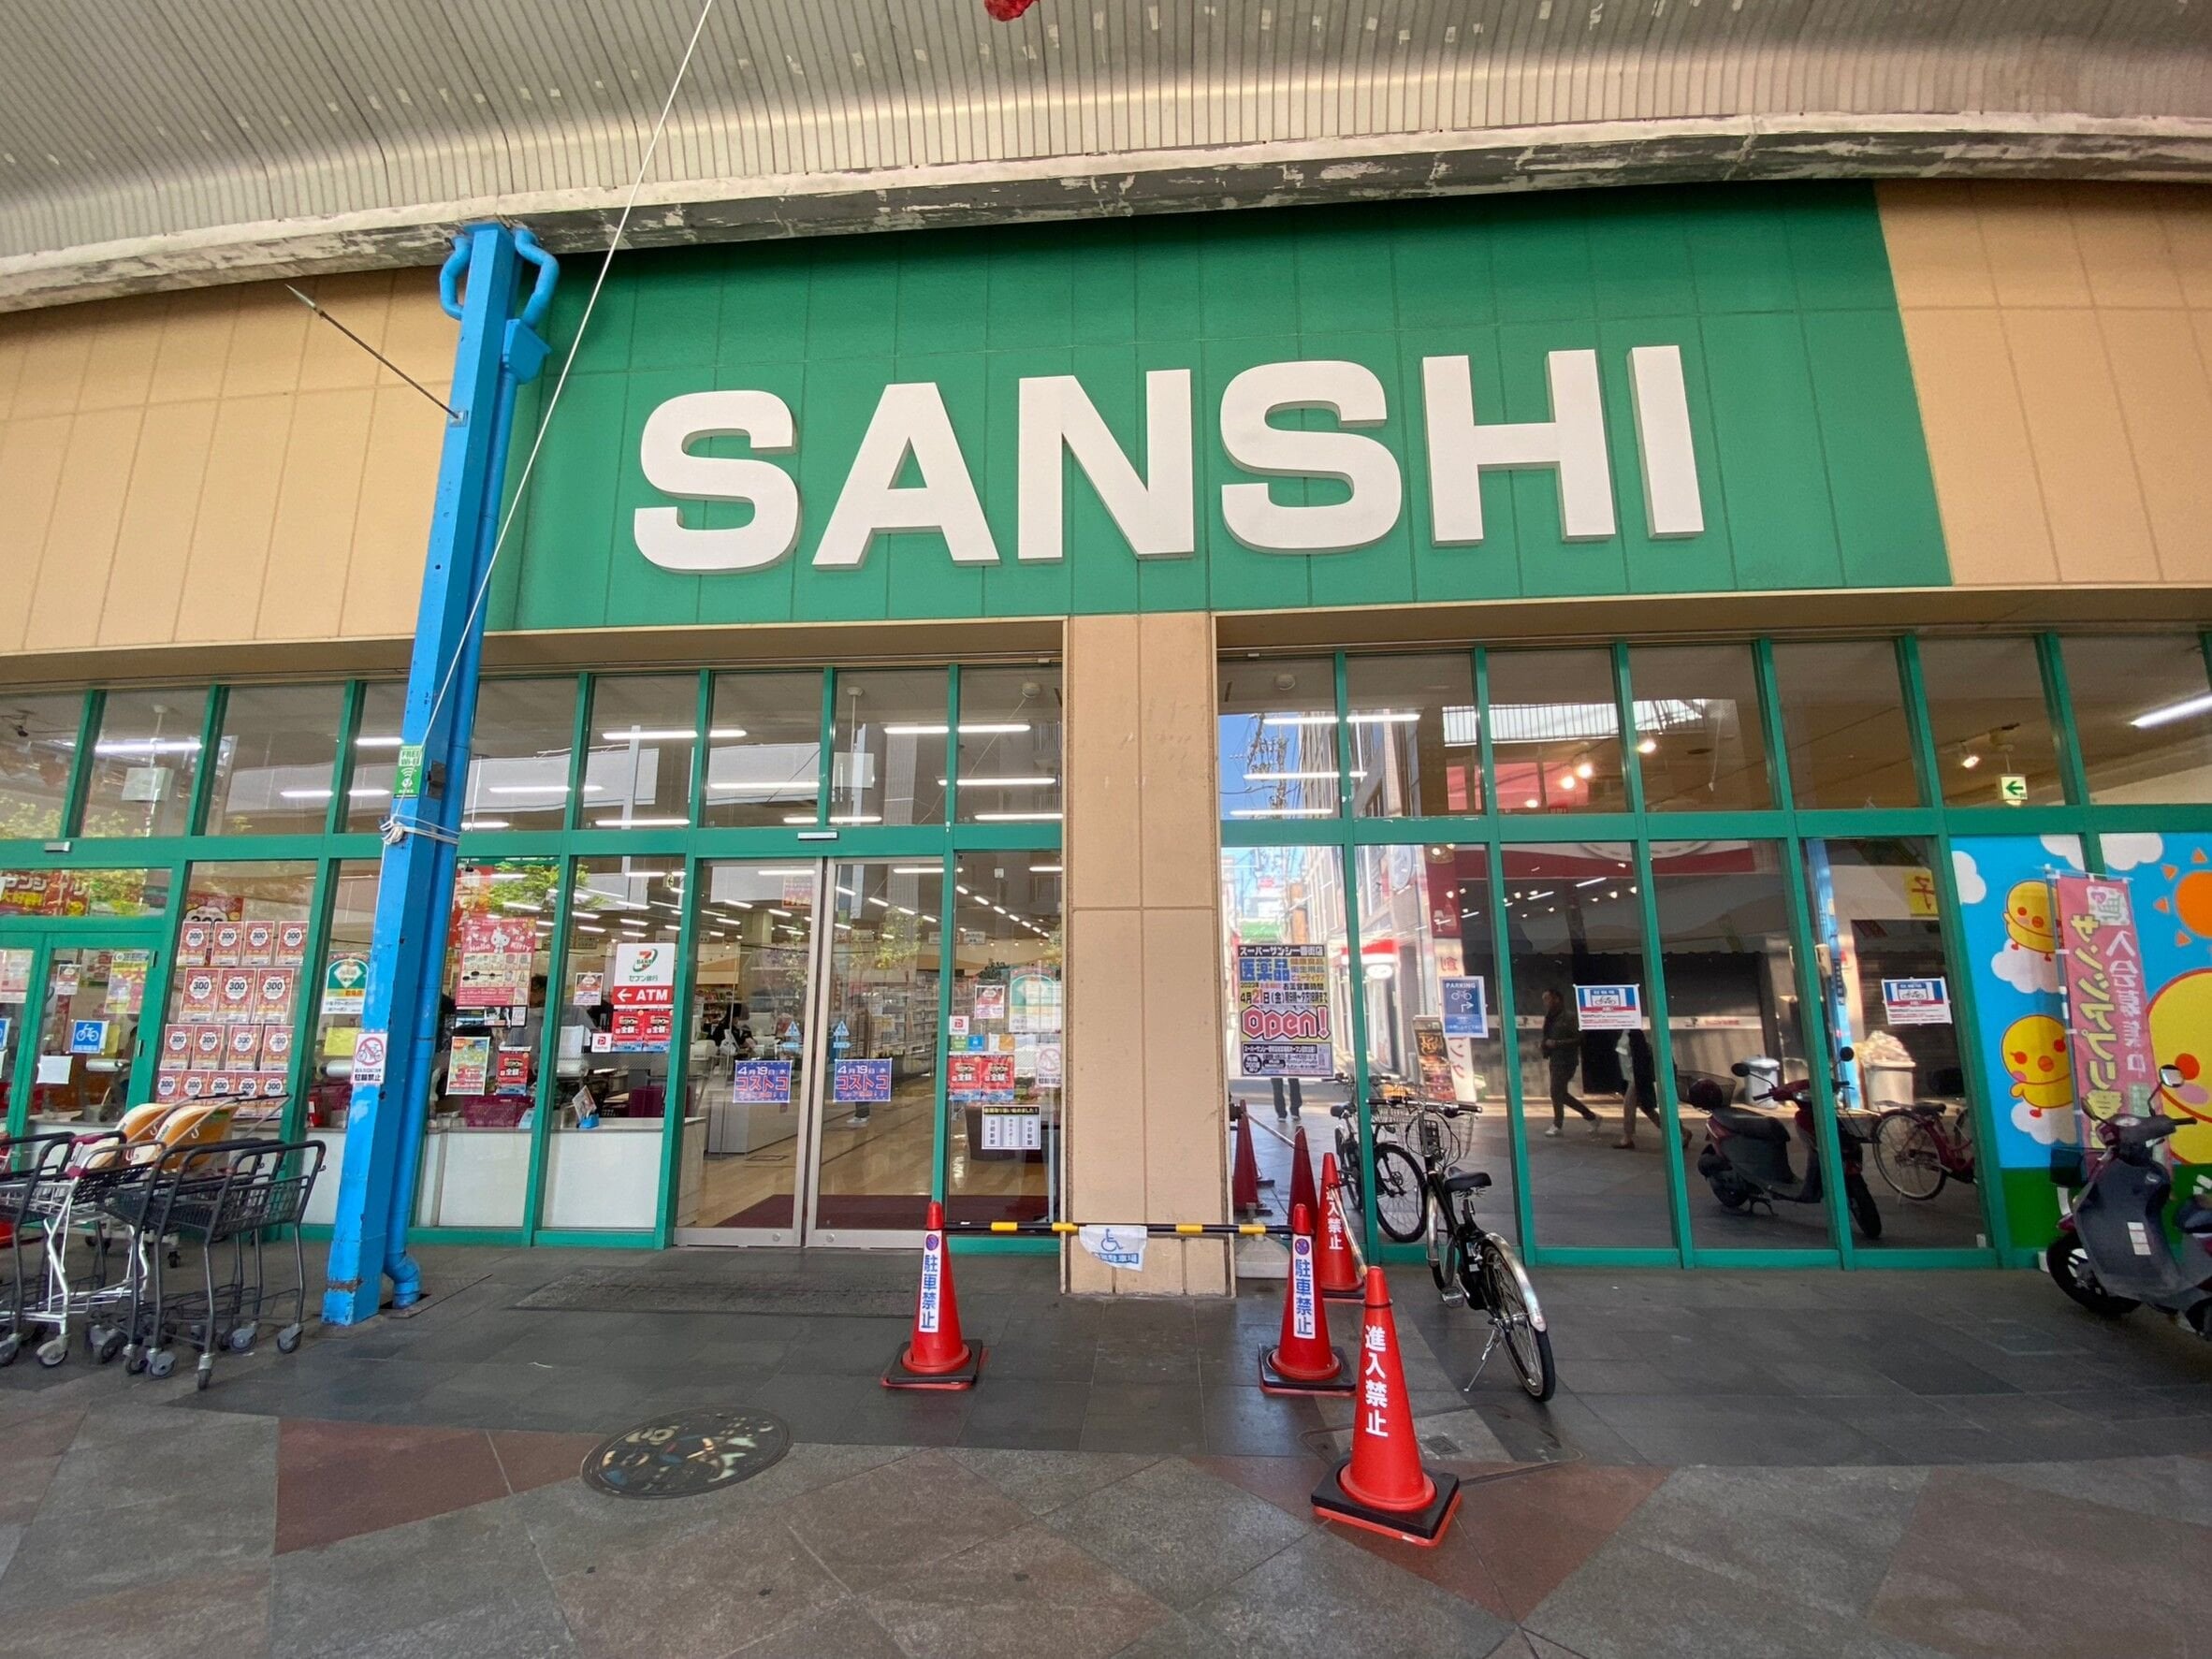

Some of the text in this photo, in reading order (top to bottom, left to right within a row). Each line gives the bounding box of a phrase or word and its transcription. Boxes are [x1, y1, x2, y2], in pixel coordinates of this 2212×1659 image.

[633, 344, 1707, 575] SANSHI
[1240, 958, 1290, 982] 医薬品
[636, 989, 668, 1001] ATM
[736, 1076, 789, 1091] コストコ
[837, 1075, 889, 1091] コストコ
[921, 1254, 939, 1329] 駐車禁止
[1295, 1259, 1313, 1336] 駐車禁止
[1364, 1324, 1389, 1438] 進入禁止
